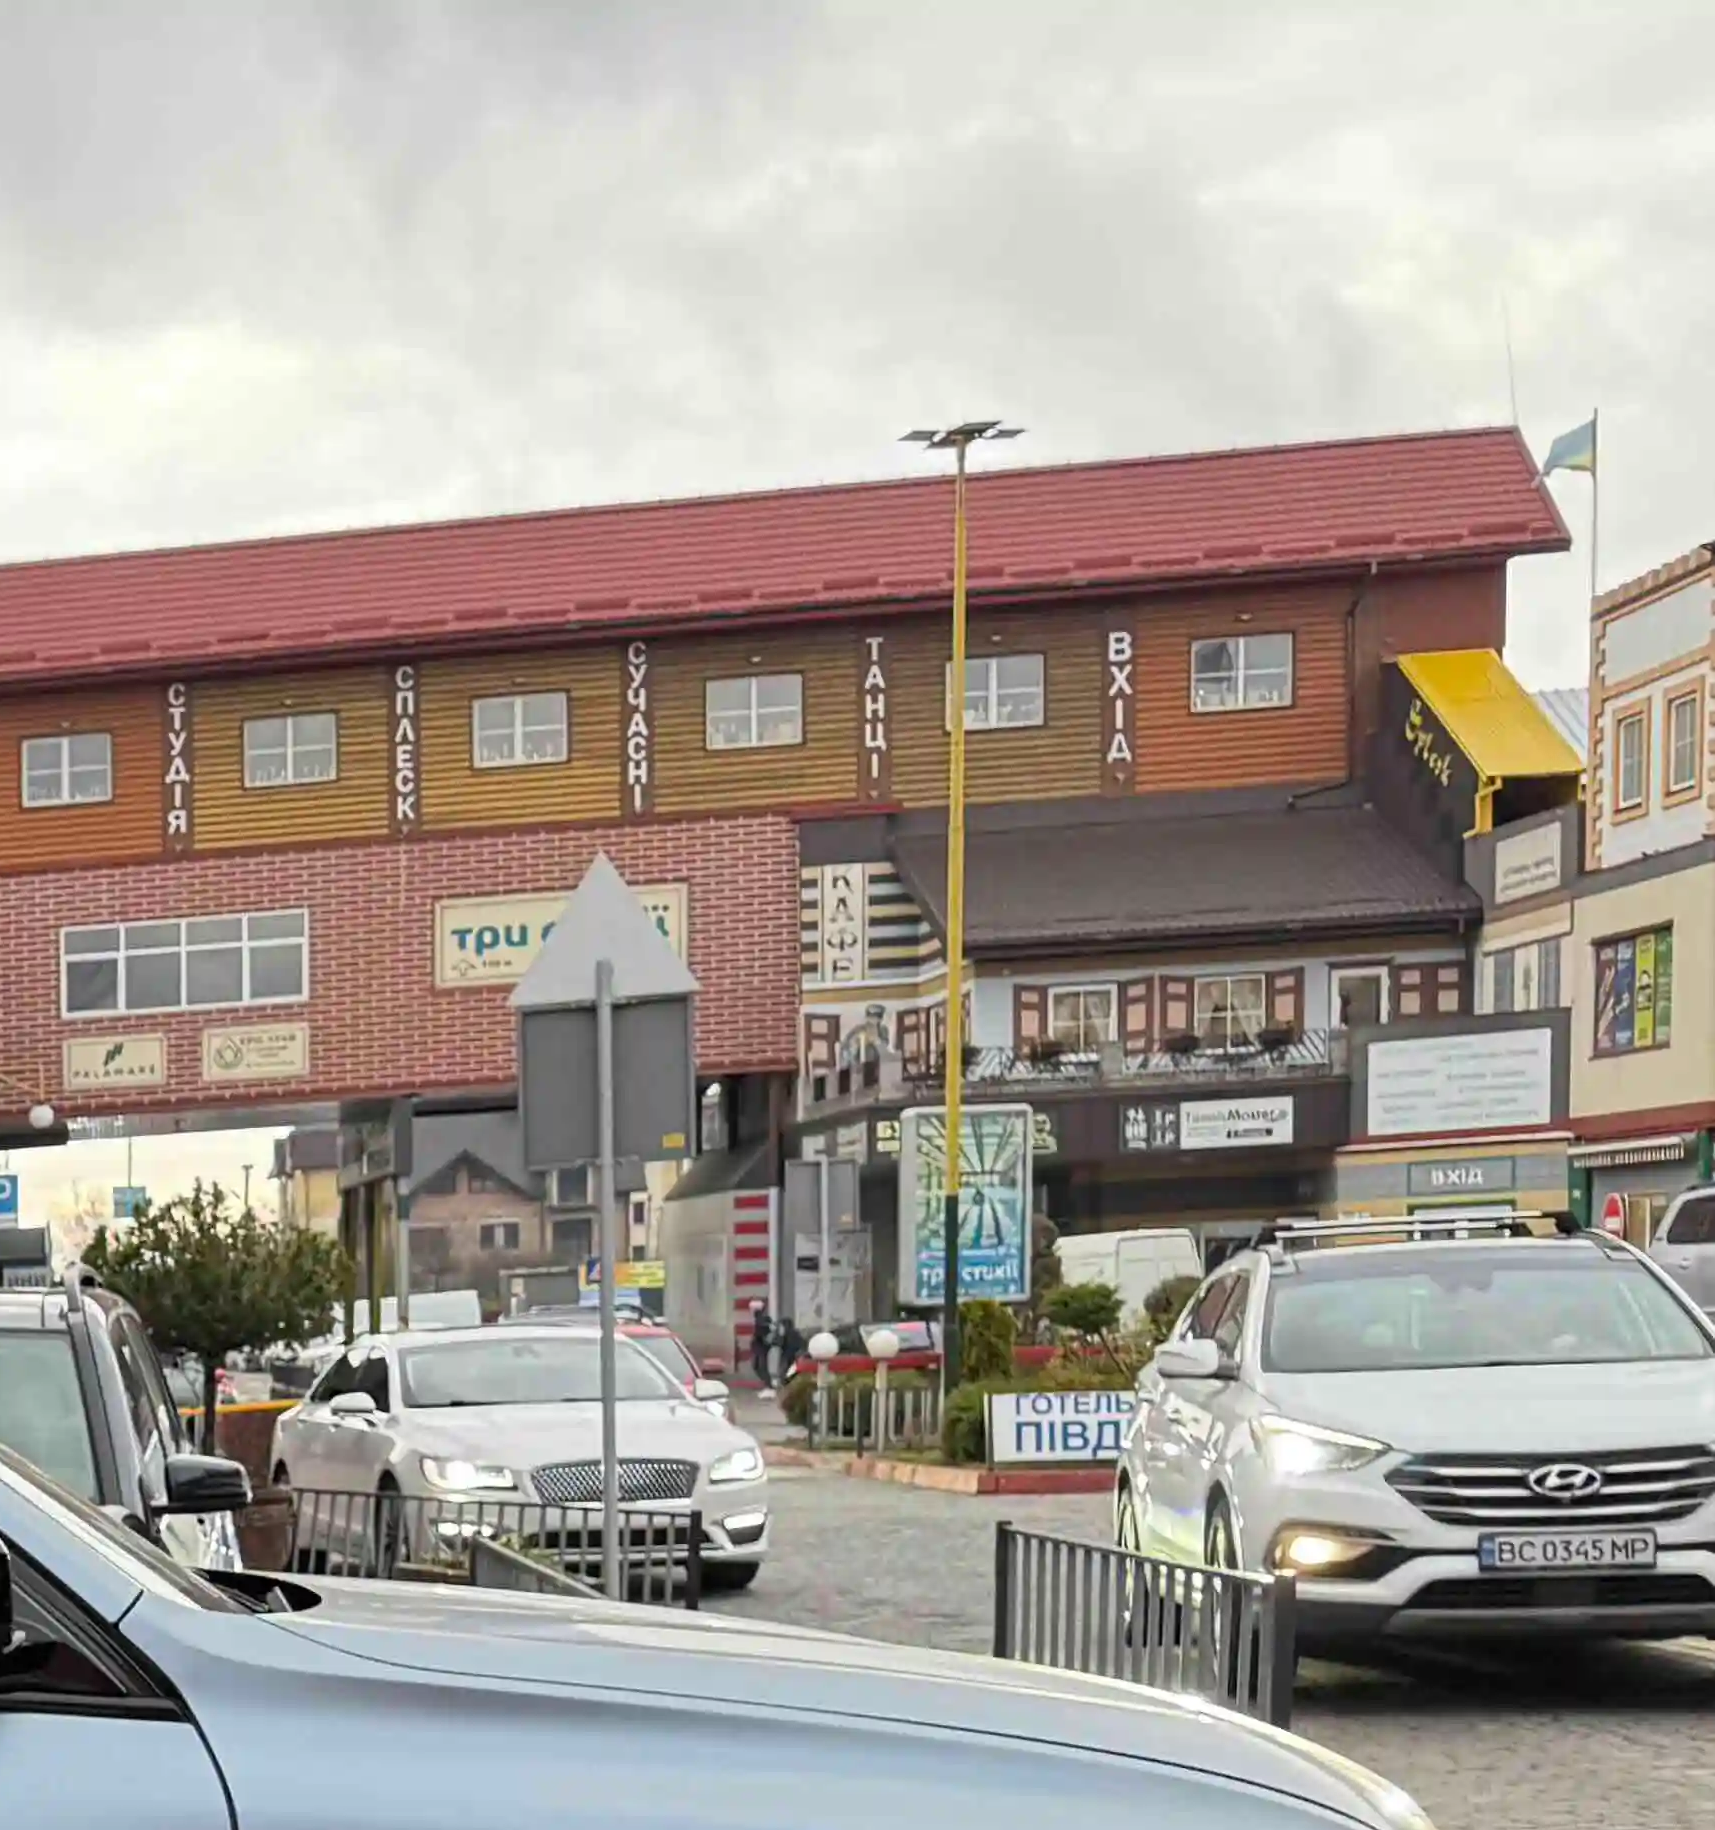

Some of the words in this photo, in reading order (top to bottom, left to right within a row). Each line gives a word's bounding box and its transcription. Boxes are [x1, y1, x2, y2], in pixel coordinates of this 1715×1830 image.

[165, 682, 191, 836] СТУДІЯ
[394, 665, 416, 820] СПЛЕСК
[626, 641, 648, 814] СУЧАСНІ
[864, 636, 888, 780] ТАНЦІ
[1015, 1393, 1134, 1416] ГОТЕЛЬ
[1497, 1541, 1536, 1563] BC
[1541, 1538, 1604, 1563] 0345
[1610, 1537, 1649, 1561] MP
